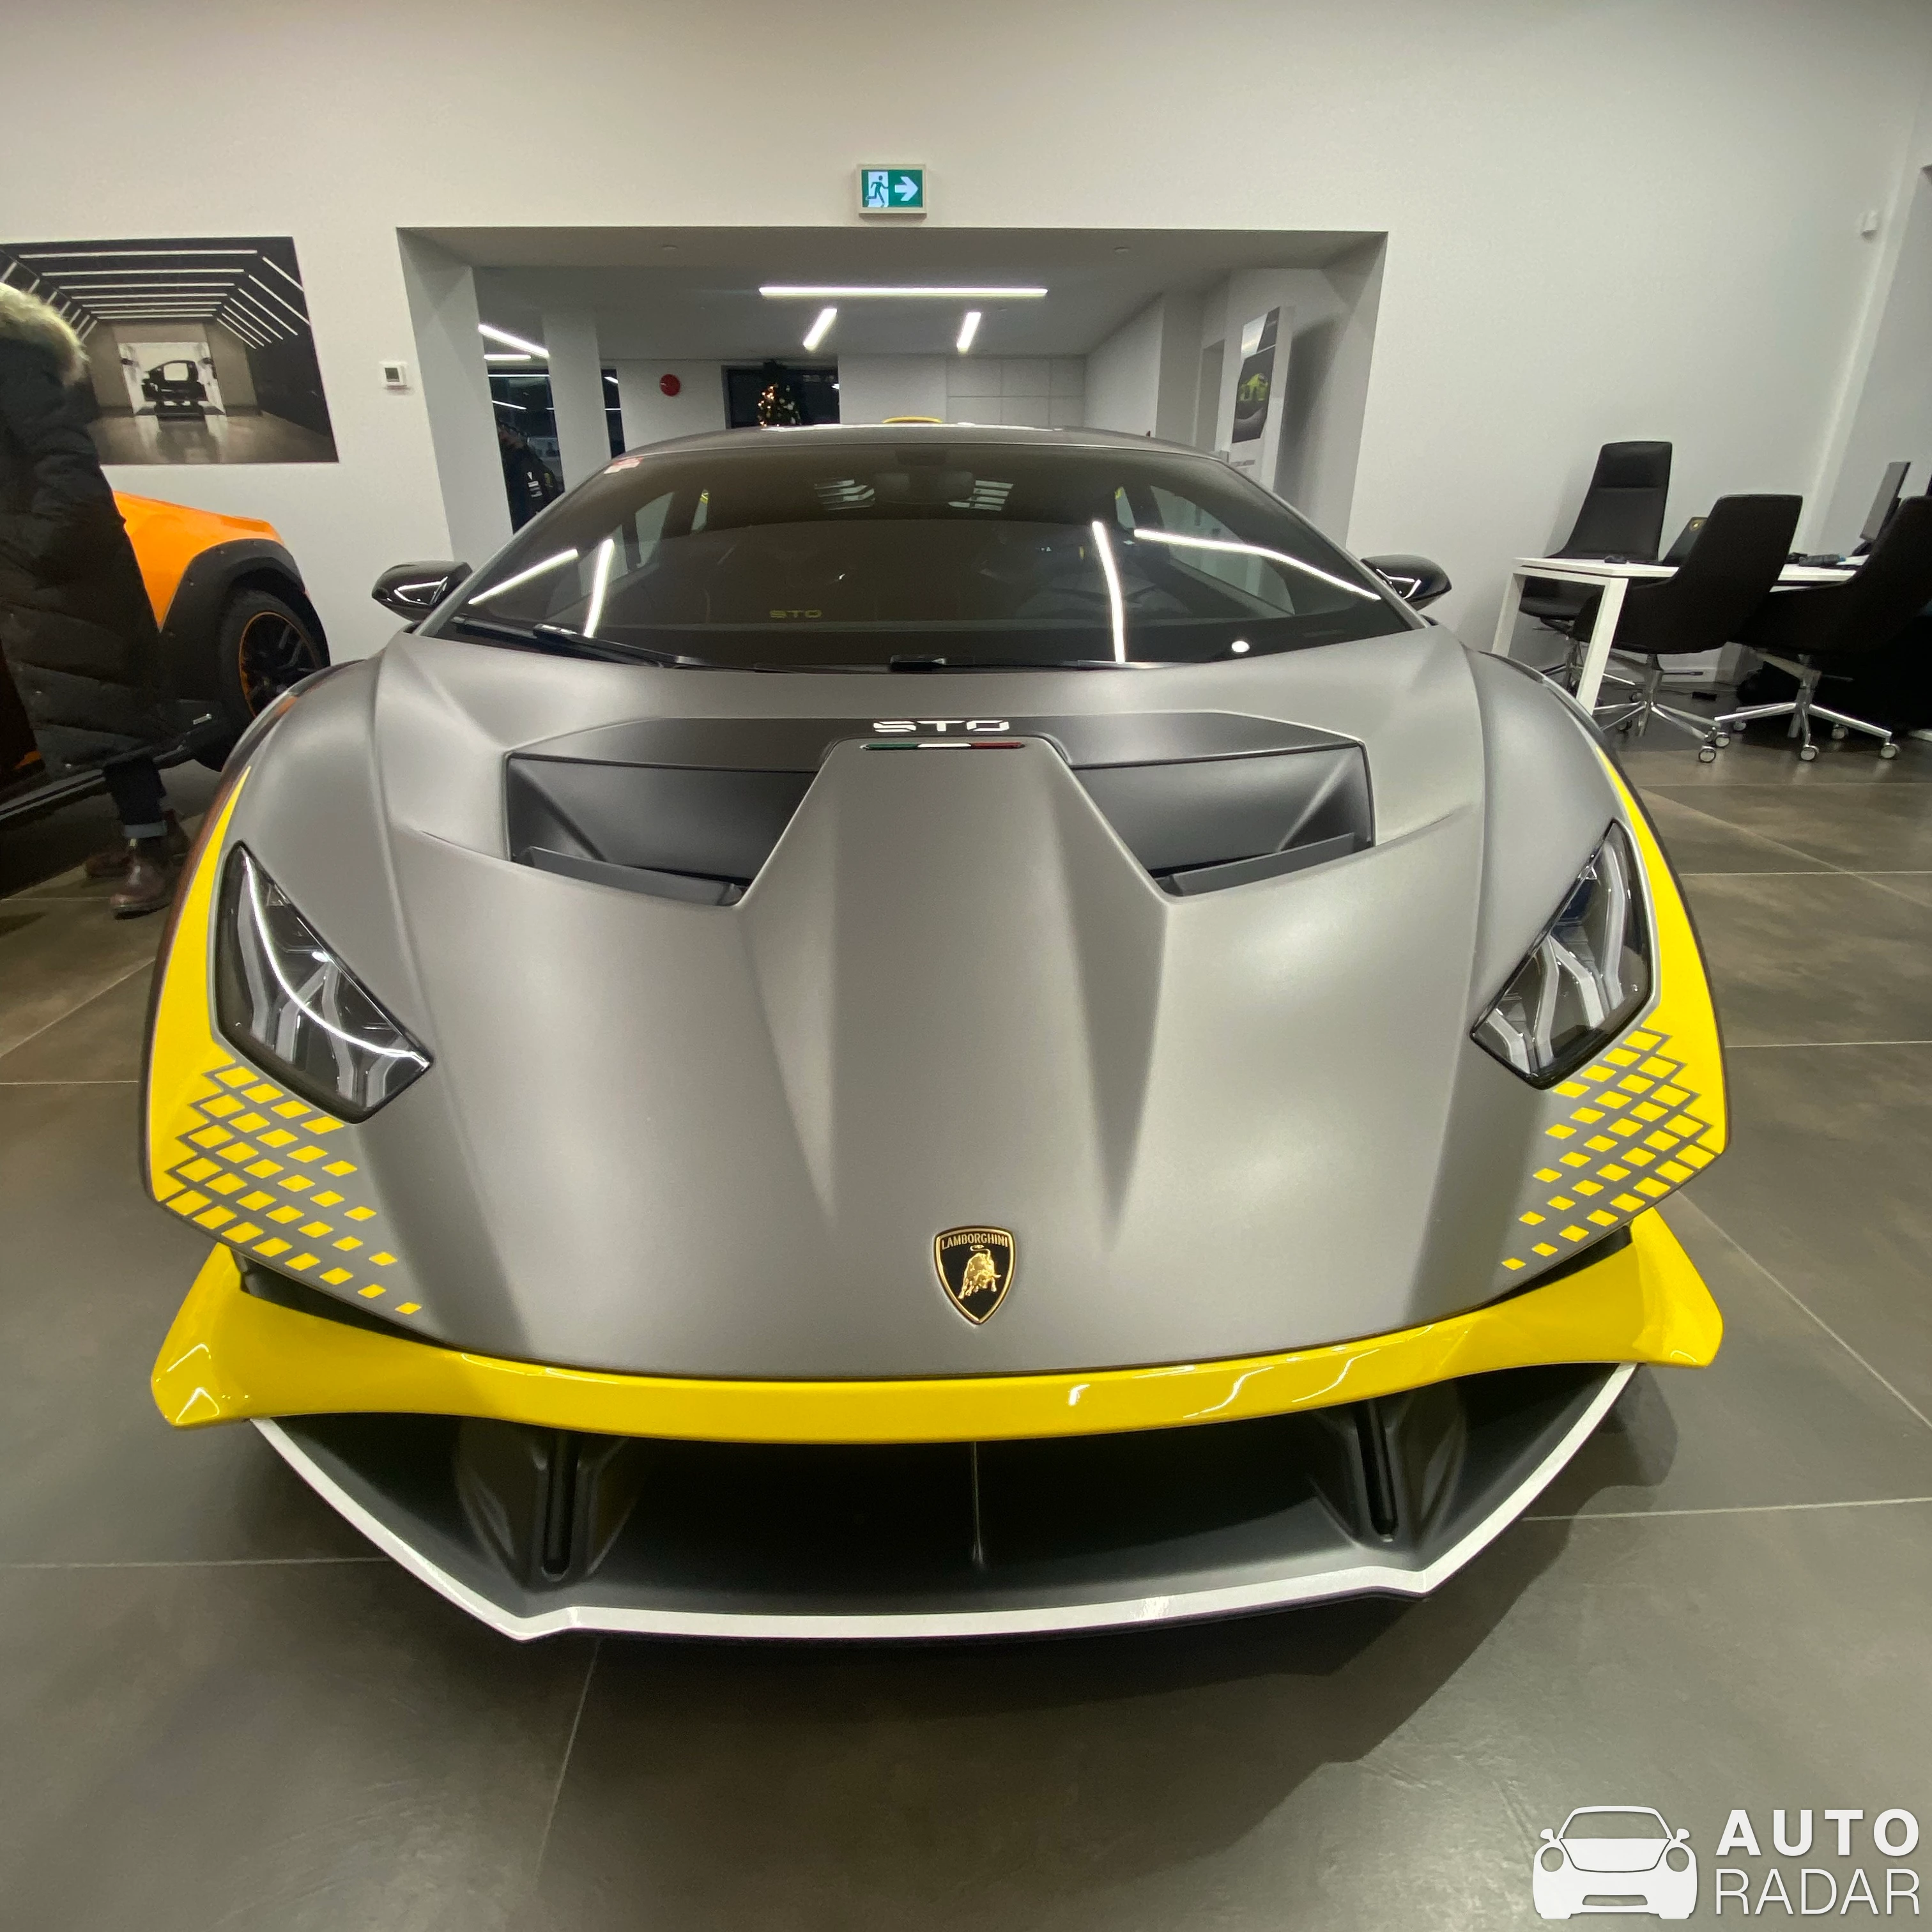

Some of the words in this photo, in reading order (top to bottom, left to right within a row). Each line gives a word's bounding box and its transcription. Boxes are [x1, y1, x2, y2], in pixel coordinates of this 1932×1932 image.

[769, 610, 822, 618] STO
[873, 719, 1010, 733] STO
[941, 1233, 1009, 1250] LAMBORGHINI
